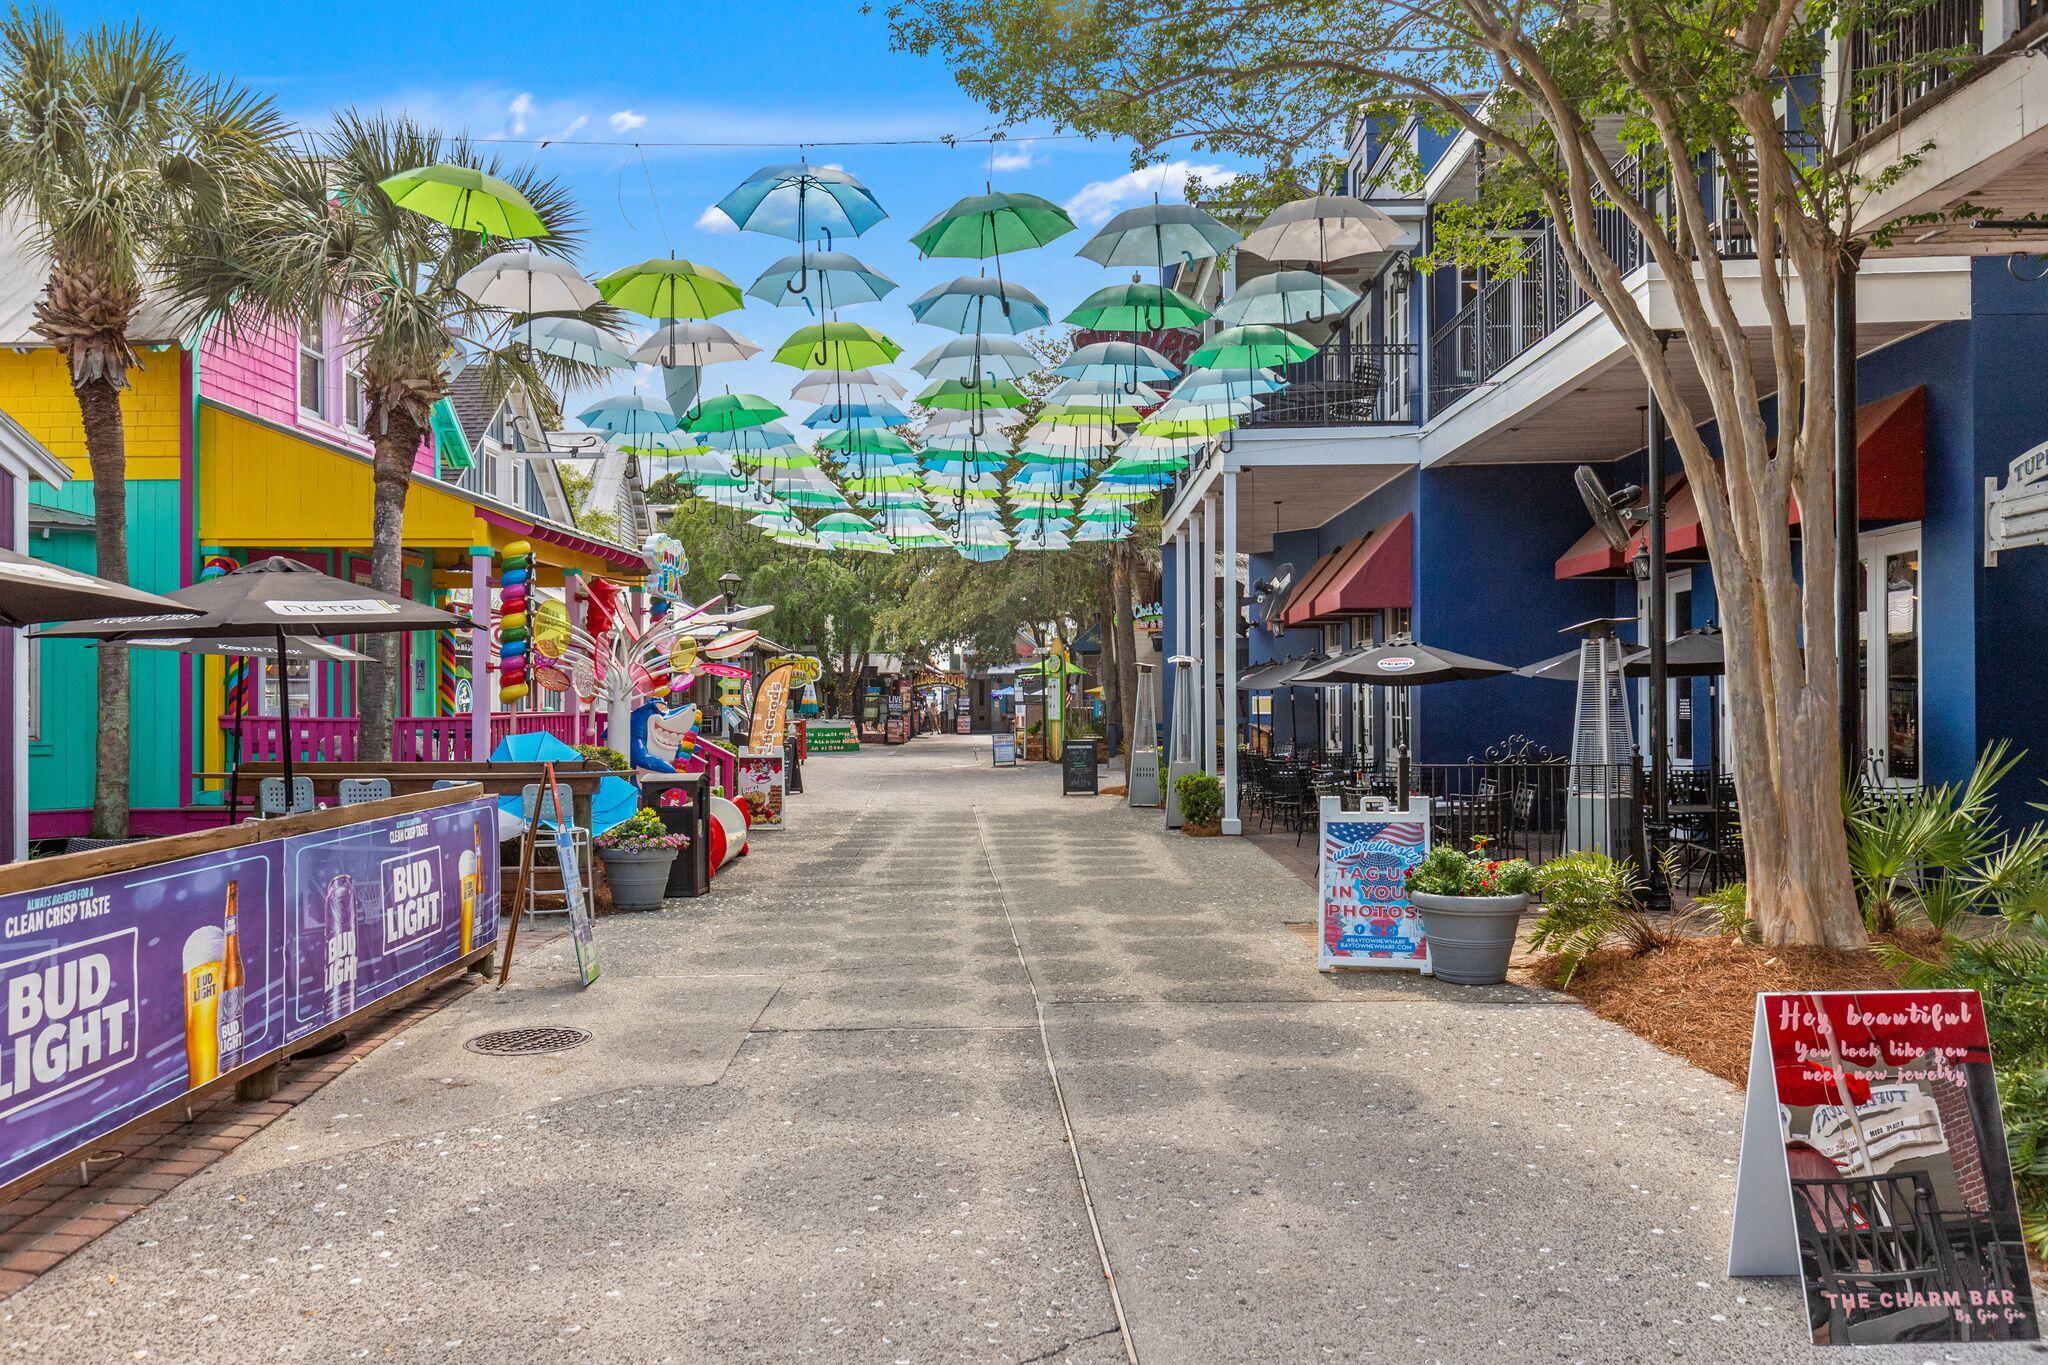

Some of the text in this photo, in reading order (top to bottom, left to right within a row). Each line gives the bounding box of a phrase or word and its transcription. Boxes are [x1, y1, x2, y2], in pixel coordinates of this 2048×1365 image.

[217, 643, 251, 652] Keep
[765, 682, 781, 731] Goods
[889, 695, 902, 703] LIVE
[389, 828, 404, 844] CLEAN
[1333, 840, 1393, 862] umbrella
[393, 859, 432, 903] BUD
[1338, 867, 1380, 880] TAG
[26, 886, 94, 912] ALWAYS BREWED FOR A
[1332, 885, 1352, 898] IN
[5, 894, 111, 939] CLEAN CRISP TASTE
[387, 890, 440, 944] LIGHT
[328, 931, 356, 964] BUD
[197, 972, 213, 988] BUD
[8, 952, 111, 1036] BUD
[193, 983, 216, 1003] LIGHT
[1779, 1000, 1972, 1034] Hey beautiful
[221, 1021, 240, 1038] BUD
[220, 1032, 242, 1053] LIGHT
[1795, 1039, 1968, 1065] You look like you
[1802, 1063, 1967, 1088] need new jewelry
[1825, 1289, 2015, 1310] THE CHARM BAR
